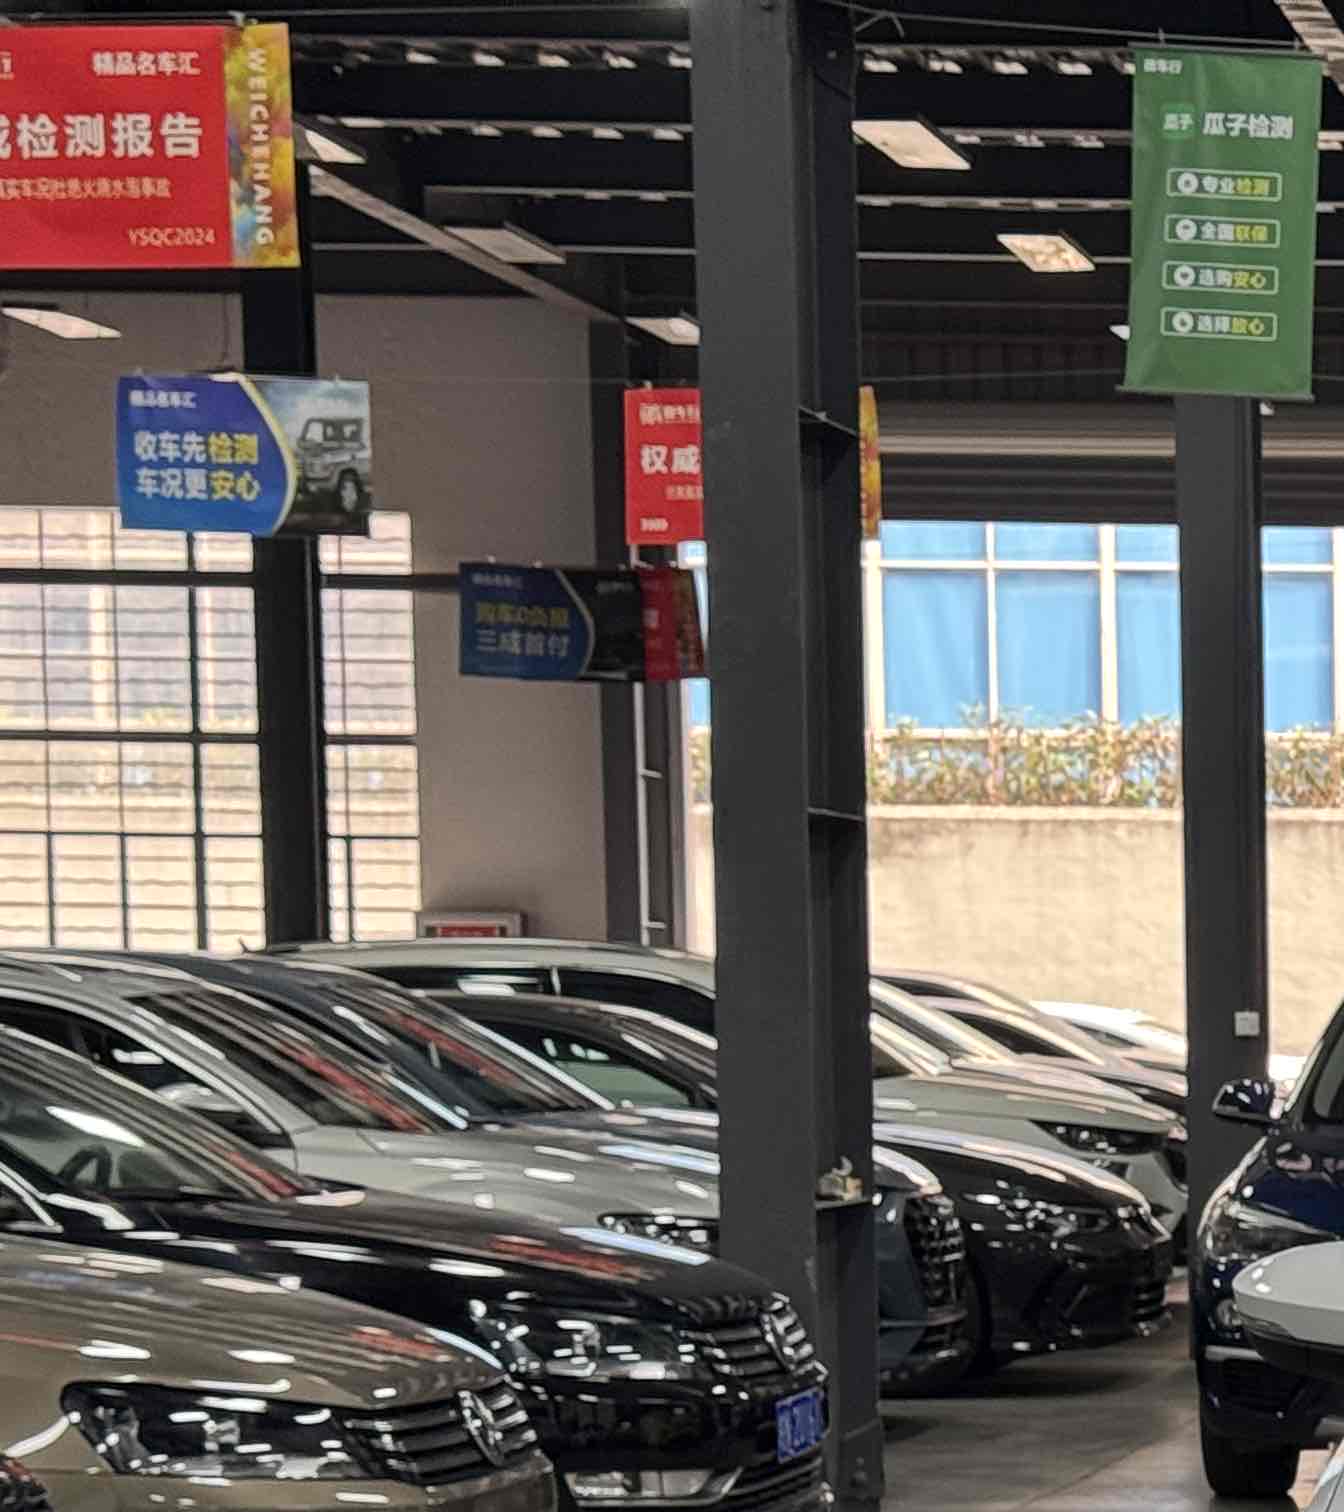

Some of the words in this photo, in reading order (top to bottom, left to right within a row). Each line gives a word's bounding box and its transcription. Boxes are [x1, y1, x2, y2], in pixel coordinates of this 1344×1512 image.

[0, 111, 203, 160] 检测报告
[1202, 112, 1294, 140] 瓜子检测
[245, 48, 274, 246] WEICHEHANG
[1201, 176, 1270, 197] 专业检测
[134, 430, 258, 465] 收车先检测
[136, 467, 260, 501] 车况更安心
